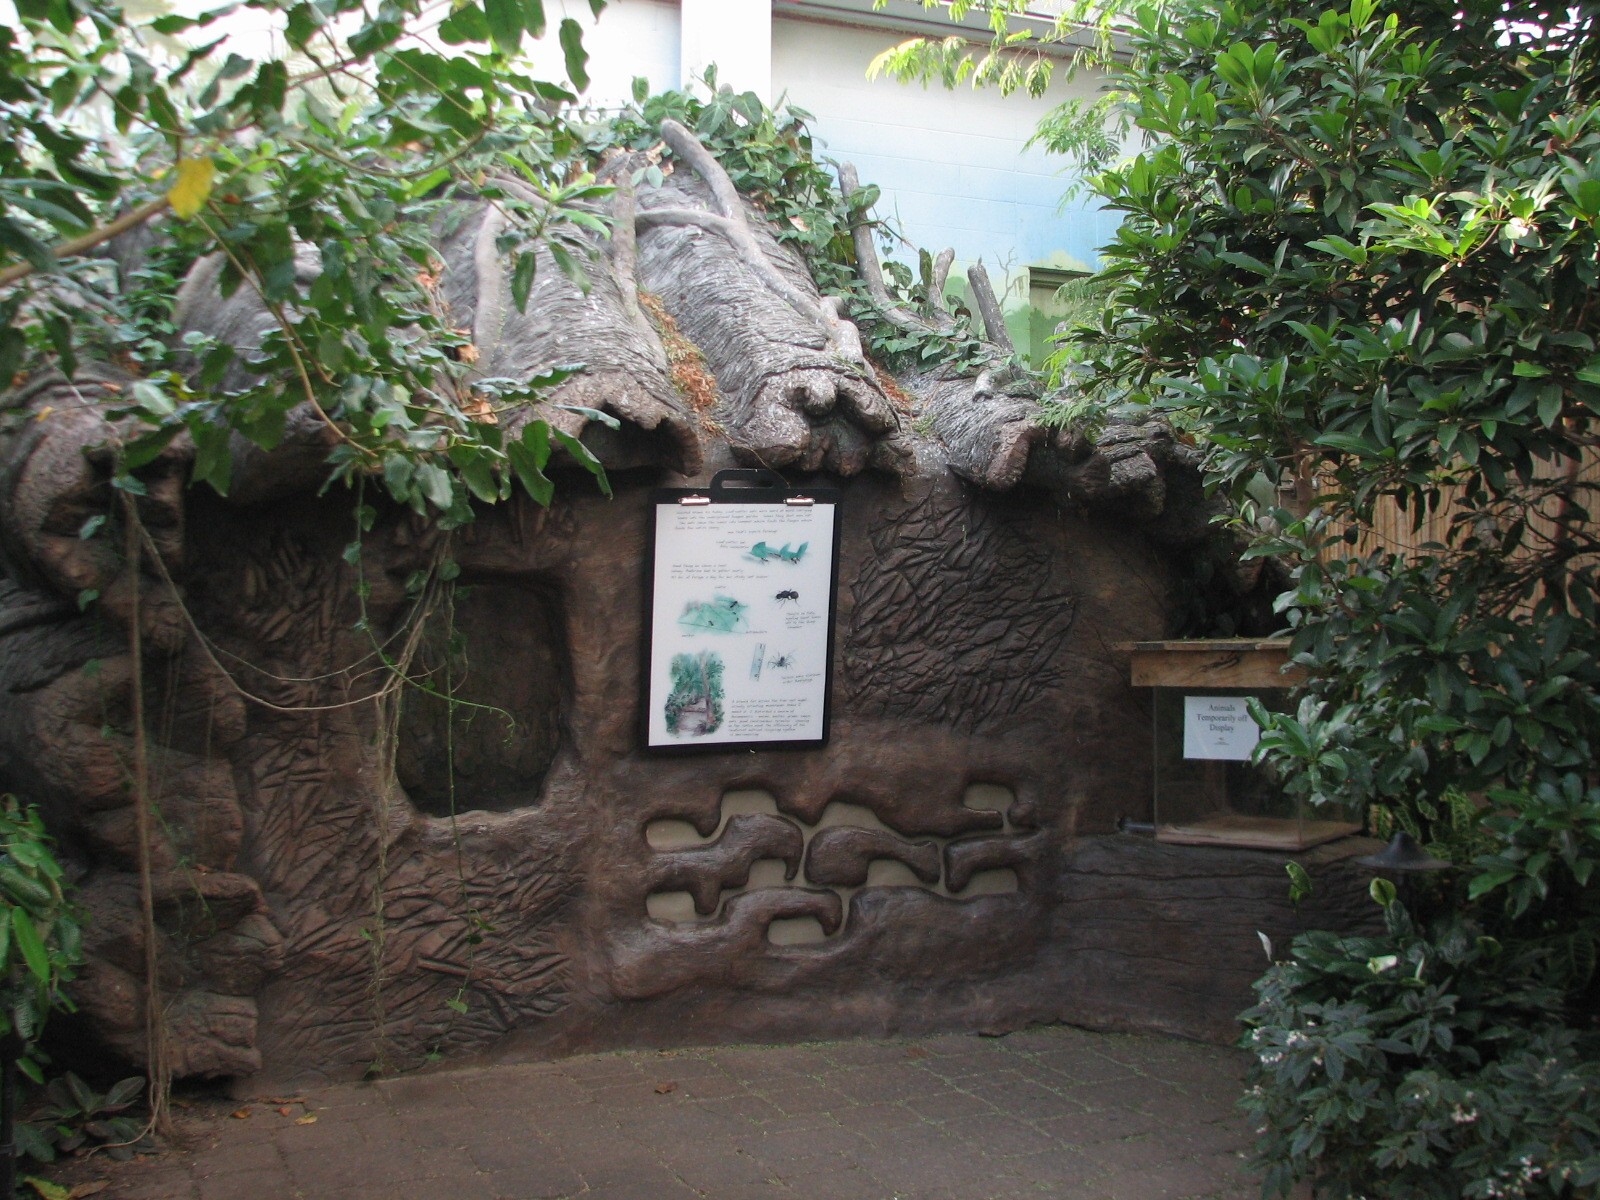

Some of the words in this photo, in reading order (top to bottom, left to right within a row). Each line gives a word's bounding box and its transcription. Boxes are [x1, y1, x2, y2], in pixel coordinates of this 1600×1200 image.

[1209, 704, 1236, 712] Animals
[1197, 713, 1235, 723] Temporarily
[1209, 724, 1234, 733] Display
